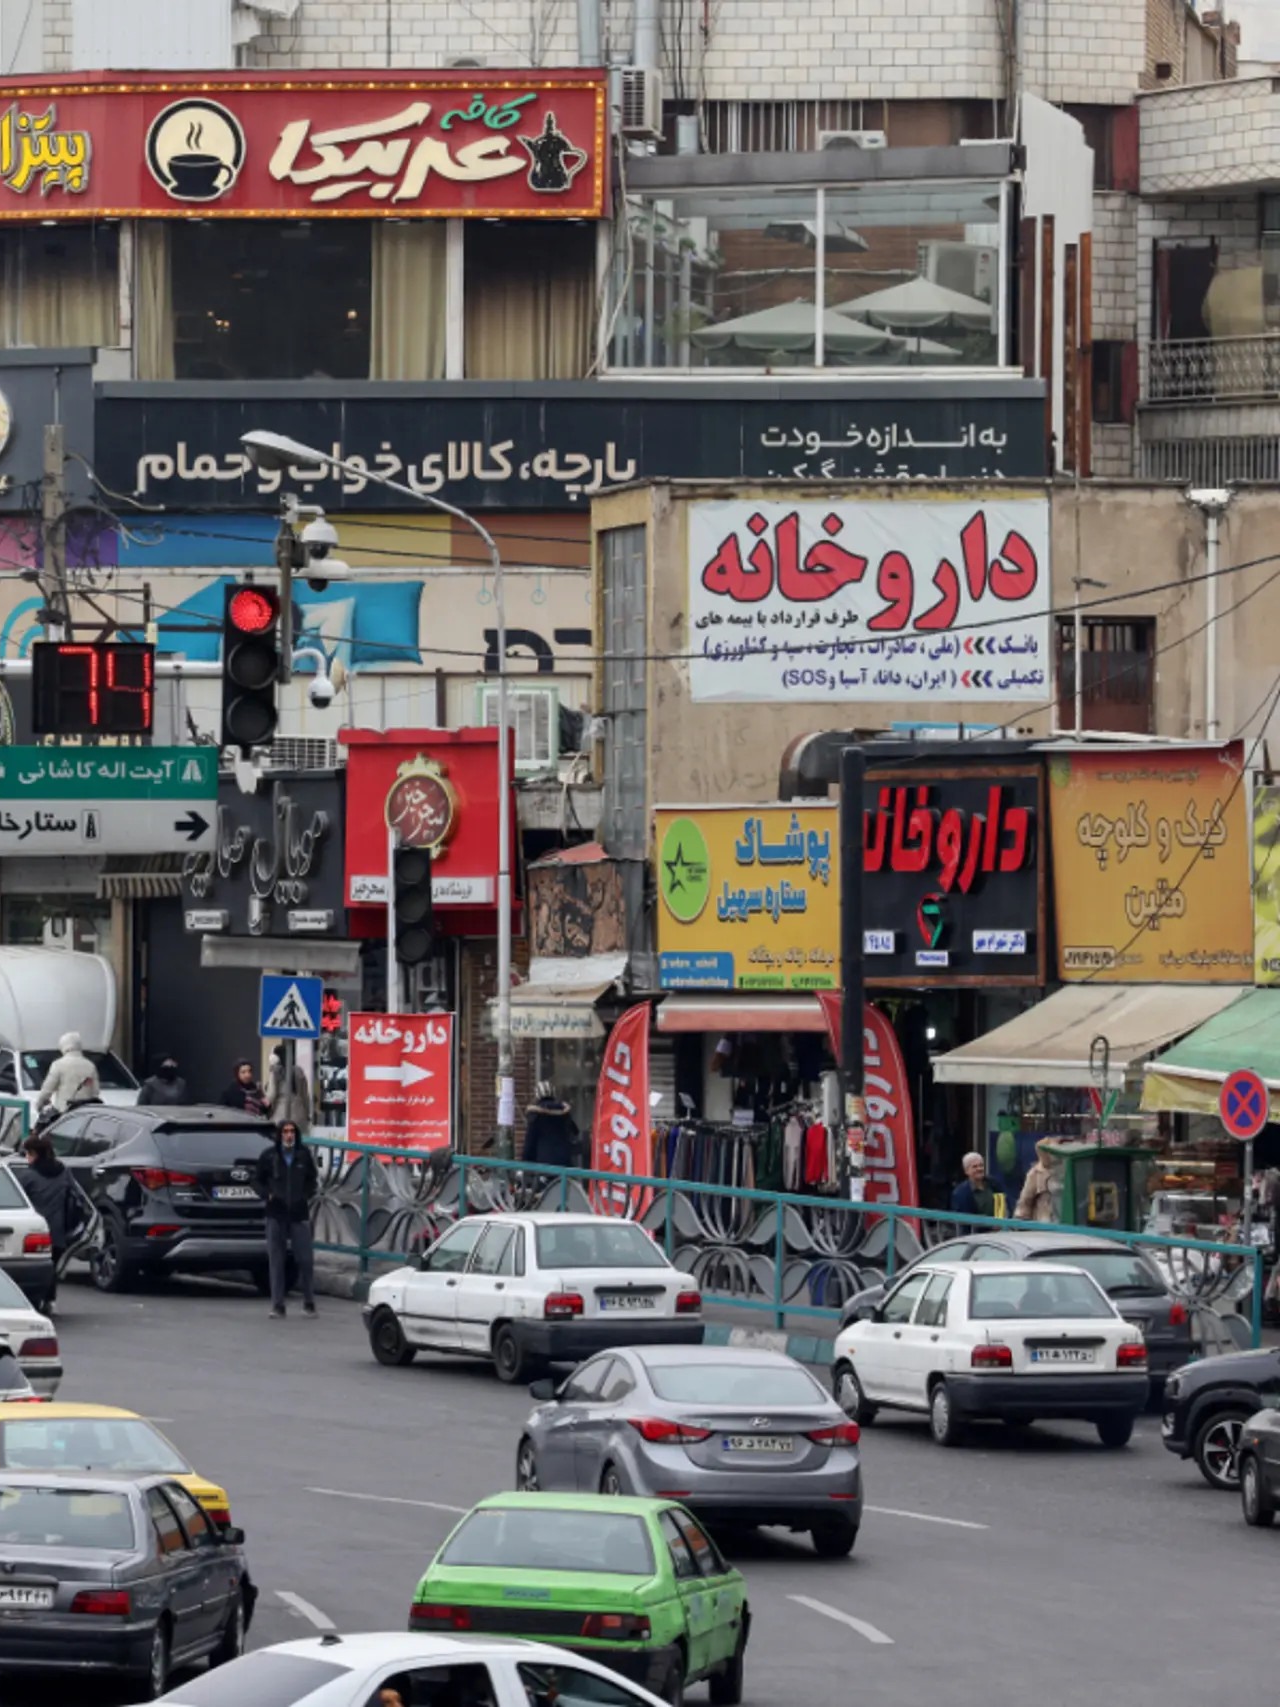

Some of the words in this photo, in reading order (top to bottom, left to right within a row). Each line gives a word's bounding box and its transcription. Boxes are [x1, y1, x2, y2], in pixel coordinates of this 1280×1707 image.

[440, 93, 537, 130] کافه
[0, 101, 92, 196] پیتزا
[269, 101, 528, 204] عربیکا
[760, 423, 864, 455] خودت
[866, 423, 976, 455] اندازه
[978, 426, 1007, 454] به
[137, 441, 252, 494] حمام
[288, 442, 403, 494] خواب
[407, 439, 514, 494] کالای
[701, 509, 1038, 632] داروخانه
[695, 611, 723, 629] های
[727, 612, 753, 627] بیمه
[757, 611, 767, 628] با
[771, 609, 820, 628] قرارداد
[825, 610, 859, 628] طرف
[998, 635, 1039, 659] بانک
[58, 646, 151, 728] 74
[839, 668, 867, 689] آسیا
[997, 670, 1045, 690] تکمیلی
[18, 758, 96, 785] کاشانی
[98, 761, 126, 778] اله
[129, 760, 174, 784] آیت
[864, 785, 1030, 893] داروخان
[1077, 799, 1151, 872] کلوچه
[1157, 816, 1171, 864] و
[1175, 798, 1227, 859] کیک
[735, 811, 831, 886] پوشاک
[717, 880, 763, 922] سهیل
[765, 878, 807, 922] ستاره
[354, 1019, 448, 1053] داروخانه
